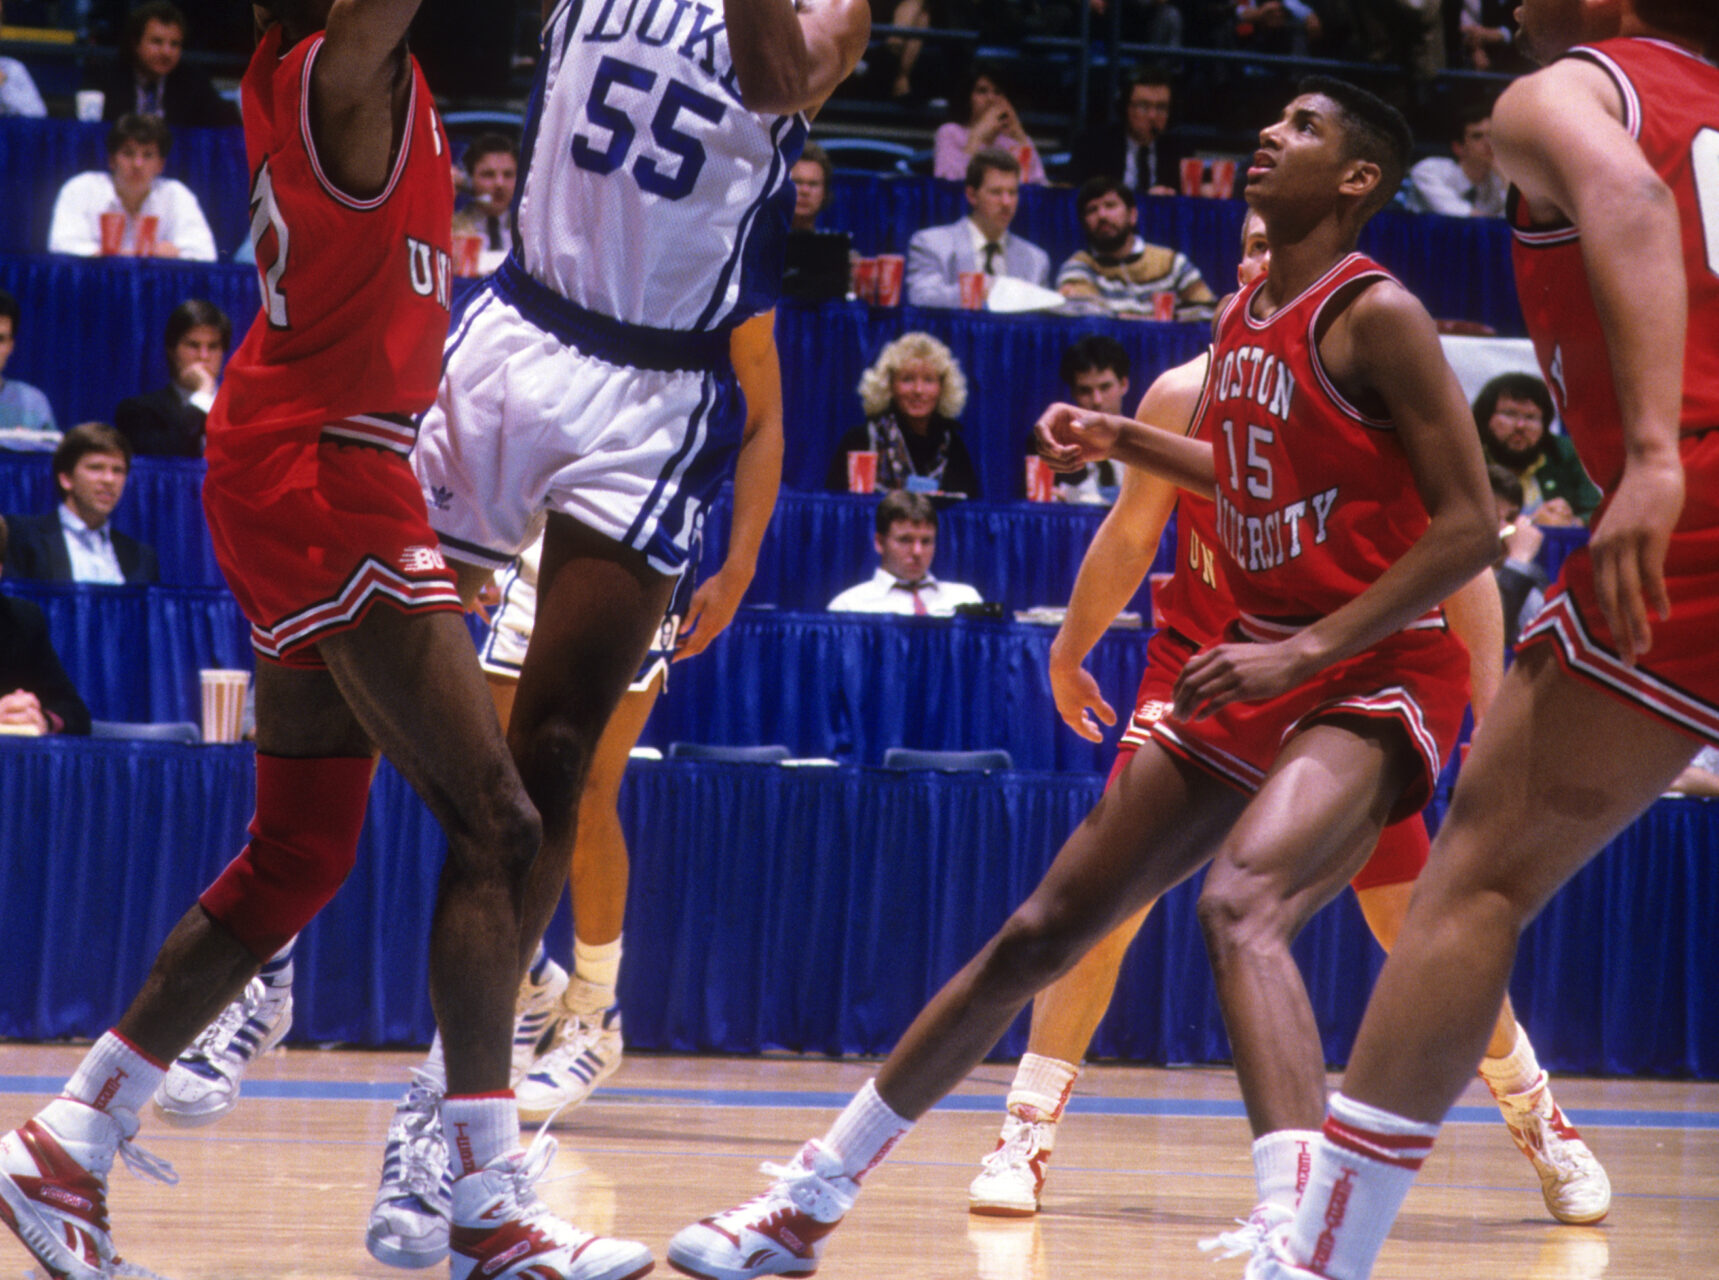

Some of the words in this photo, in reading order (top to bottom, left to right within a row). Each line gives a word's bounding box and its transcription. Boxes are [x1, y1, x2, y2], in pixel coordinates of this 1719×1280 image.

[570, 55, 727, 201] 55
[1214, 346, 1296, 420] OSTON
[1222, 420, 1273, 500] 15
